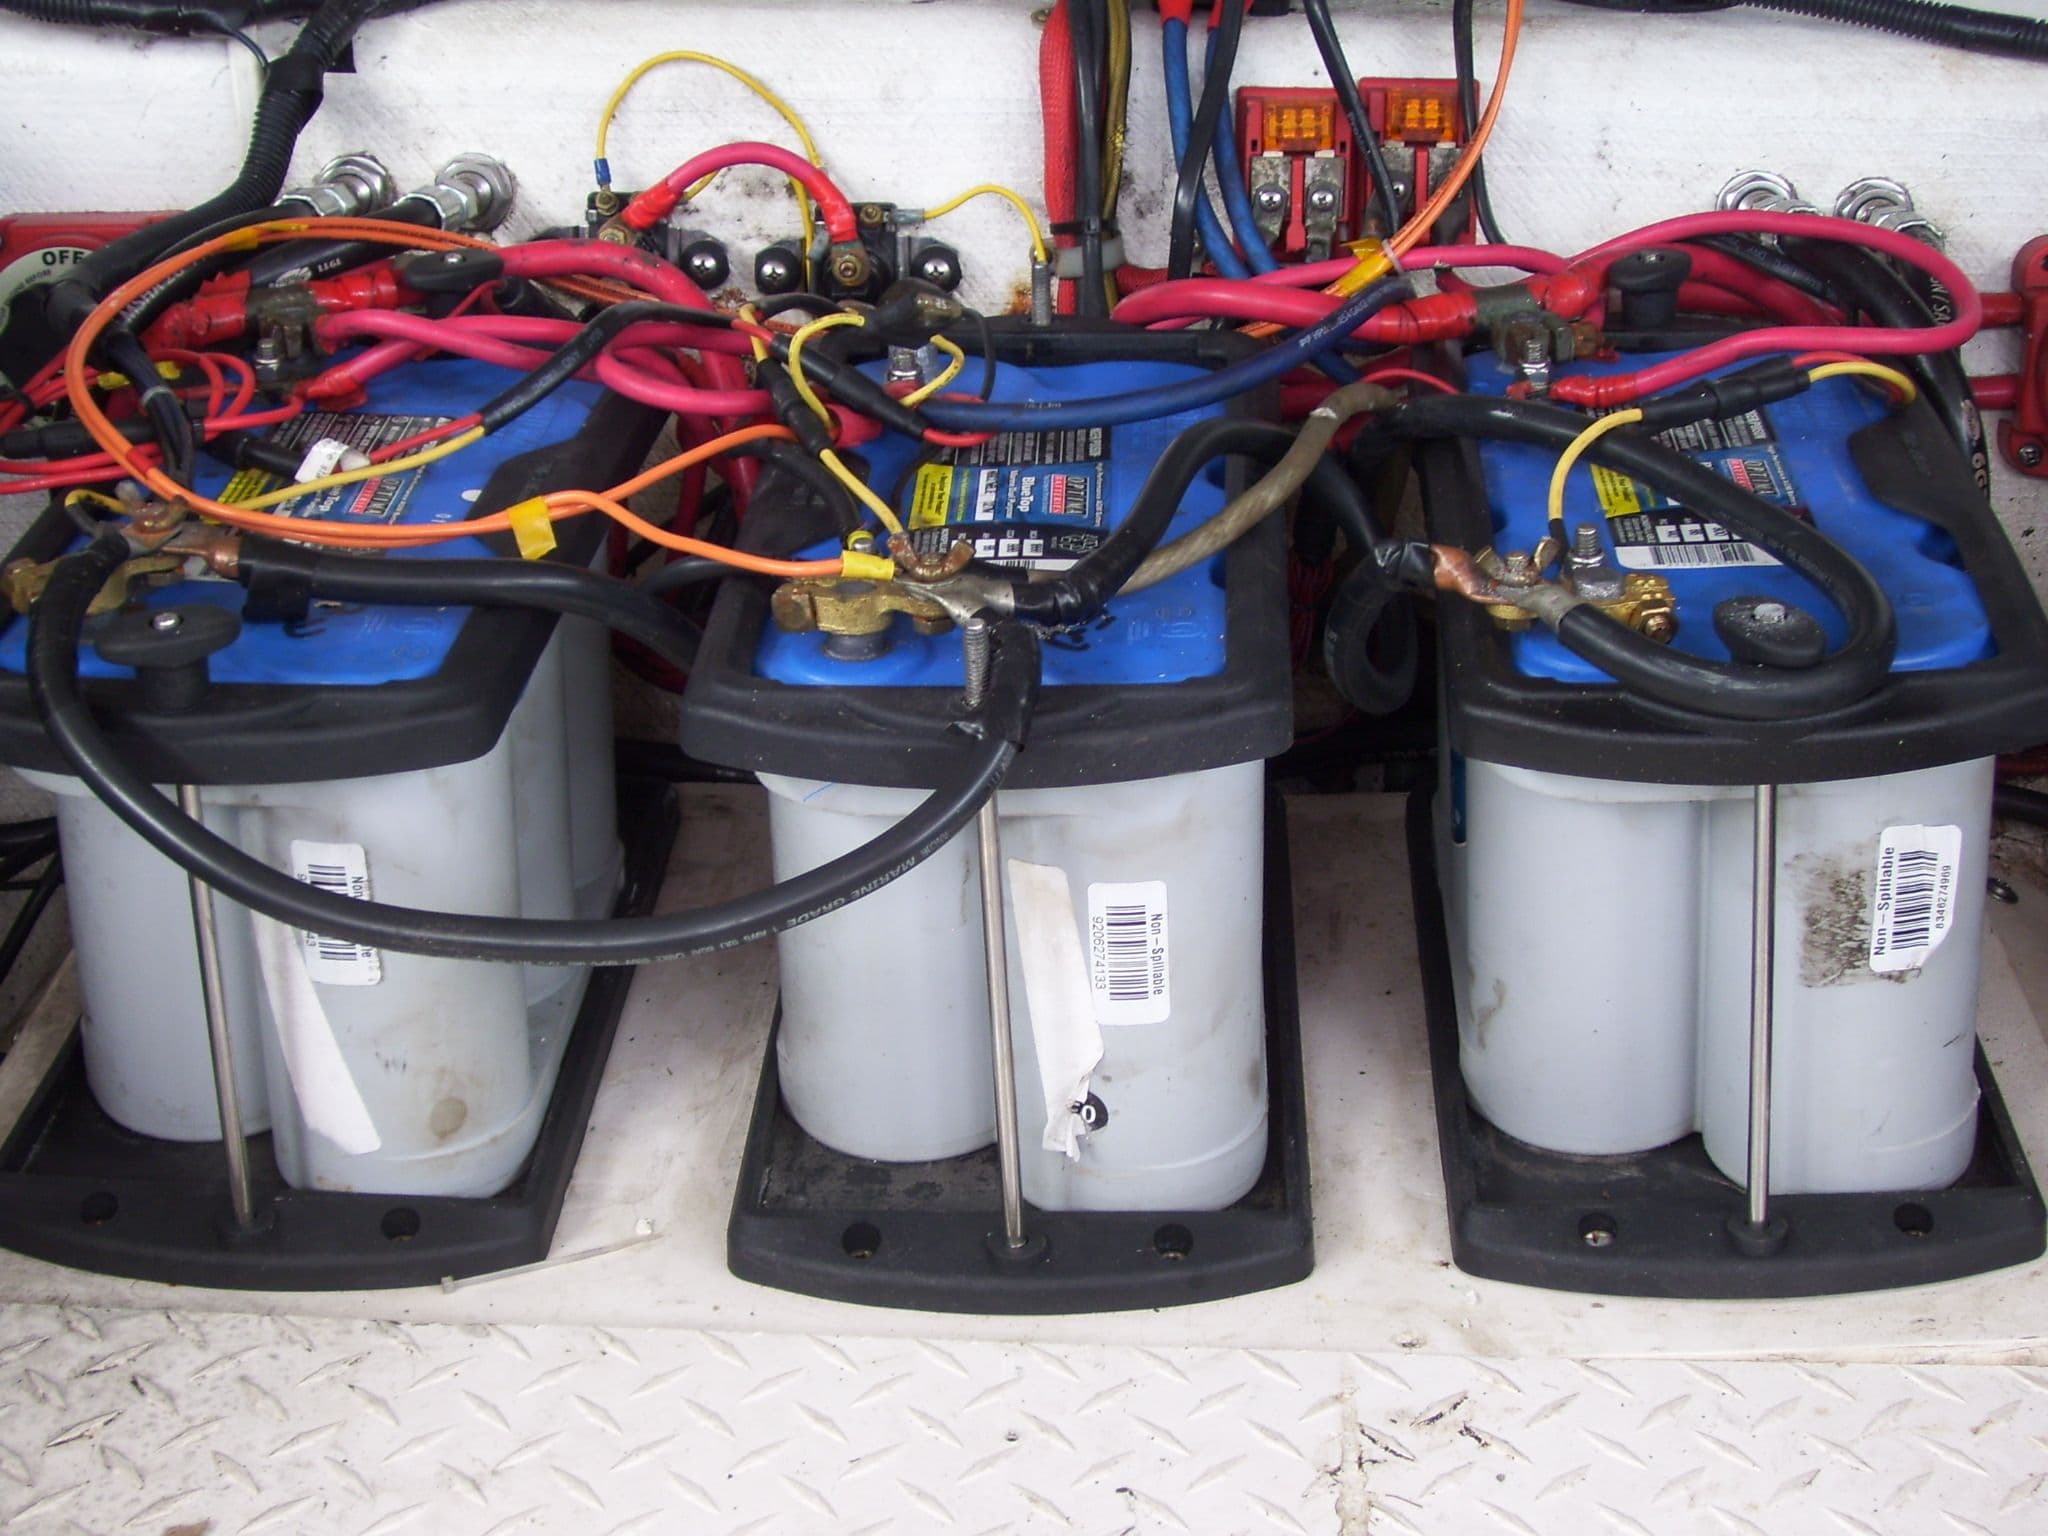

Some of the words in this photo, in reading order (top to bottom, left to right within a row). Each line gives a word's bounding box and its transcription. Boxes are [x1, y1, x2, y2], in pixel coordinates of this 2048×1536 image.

[42, 250, 85, 265] OFF
[1018, 476, 1036, 513] BlueTop
[849, 855, 916, 898] MARINE
[785, 897, 846, 928] GRADE
